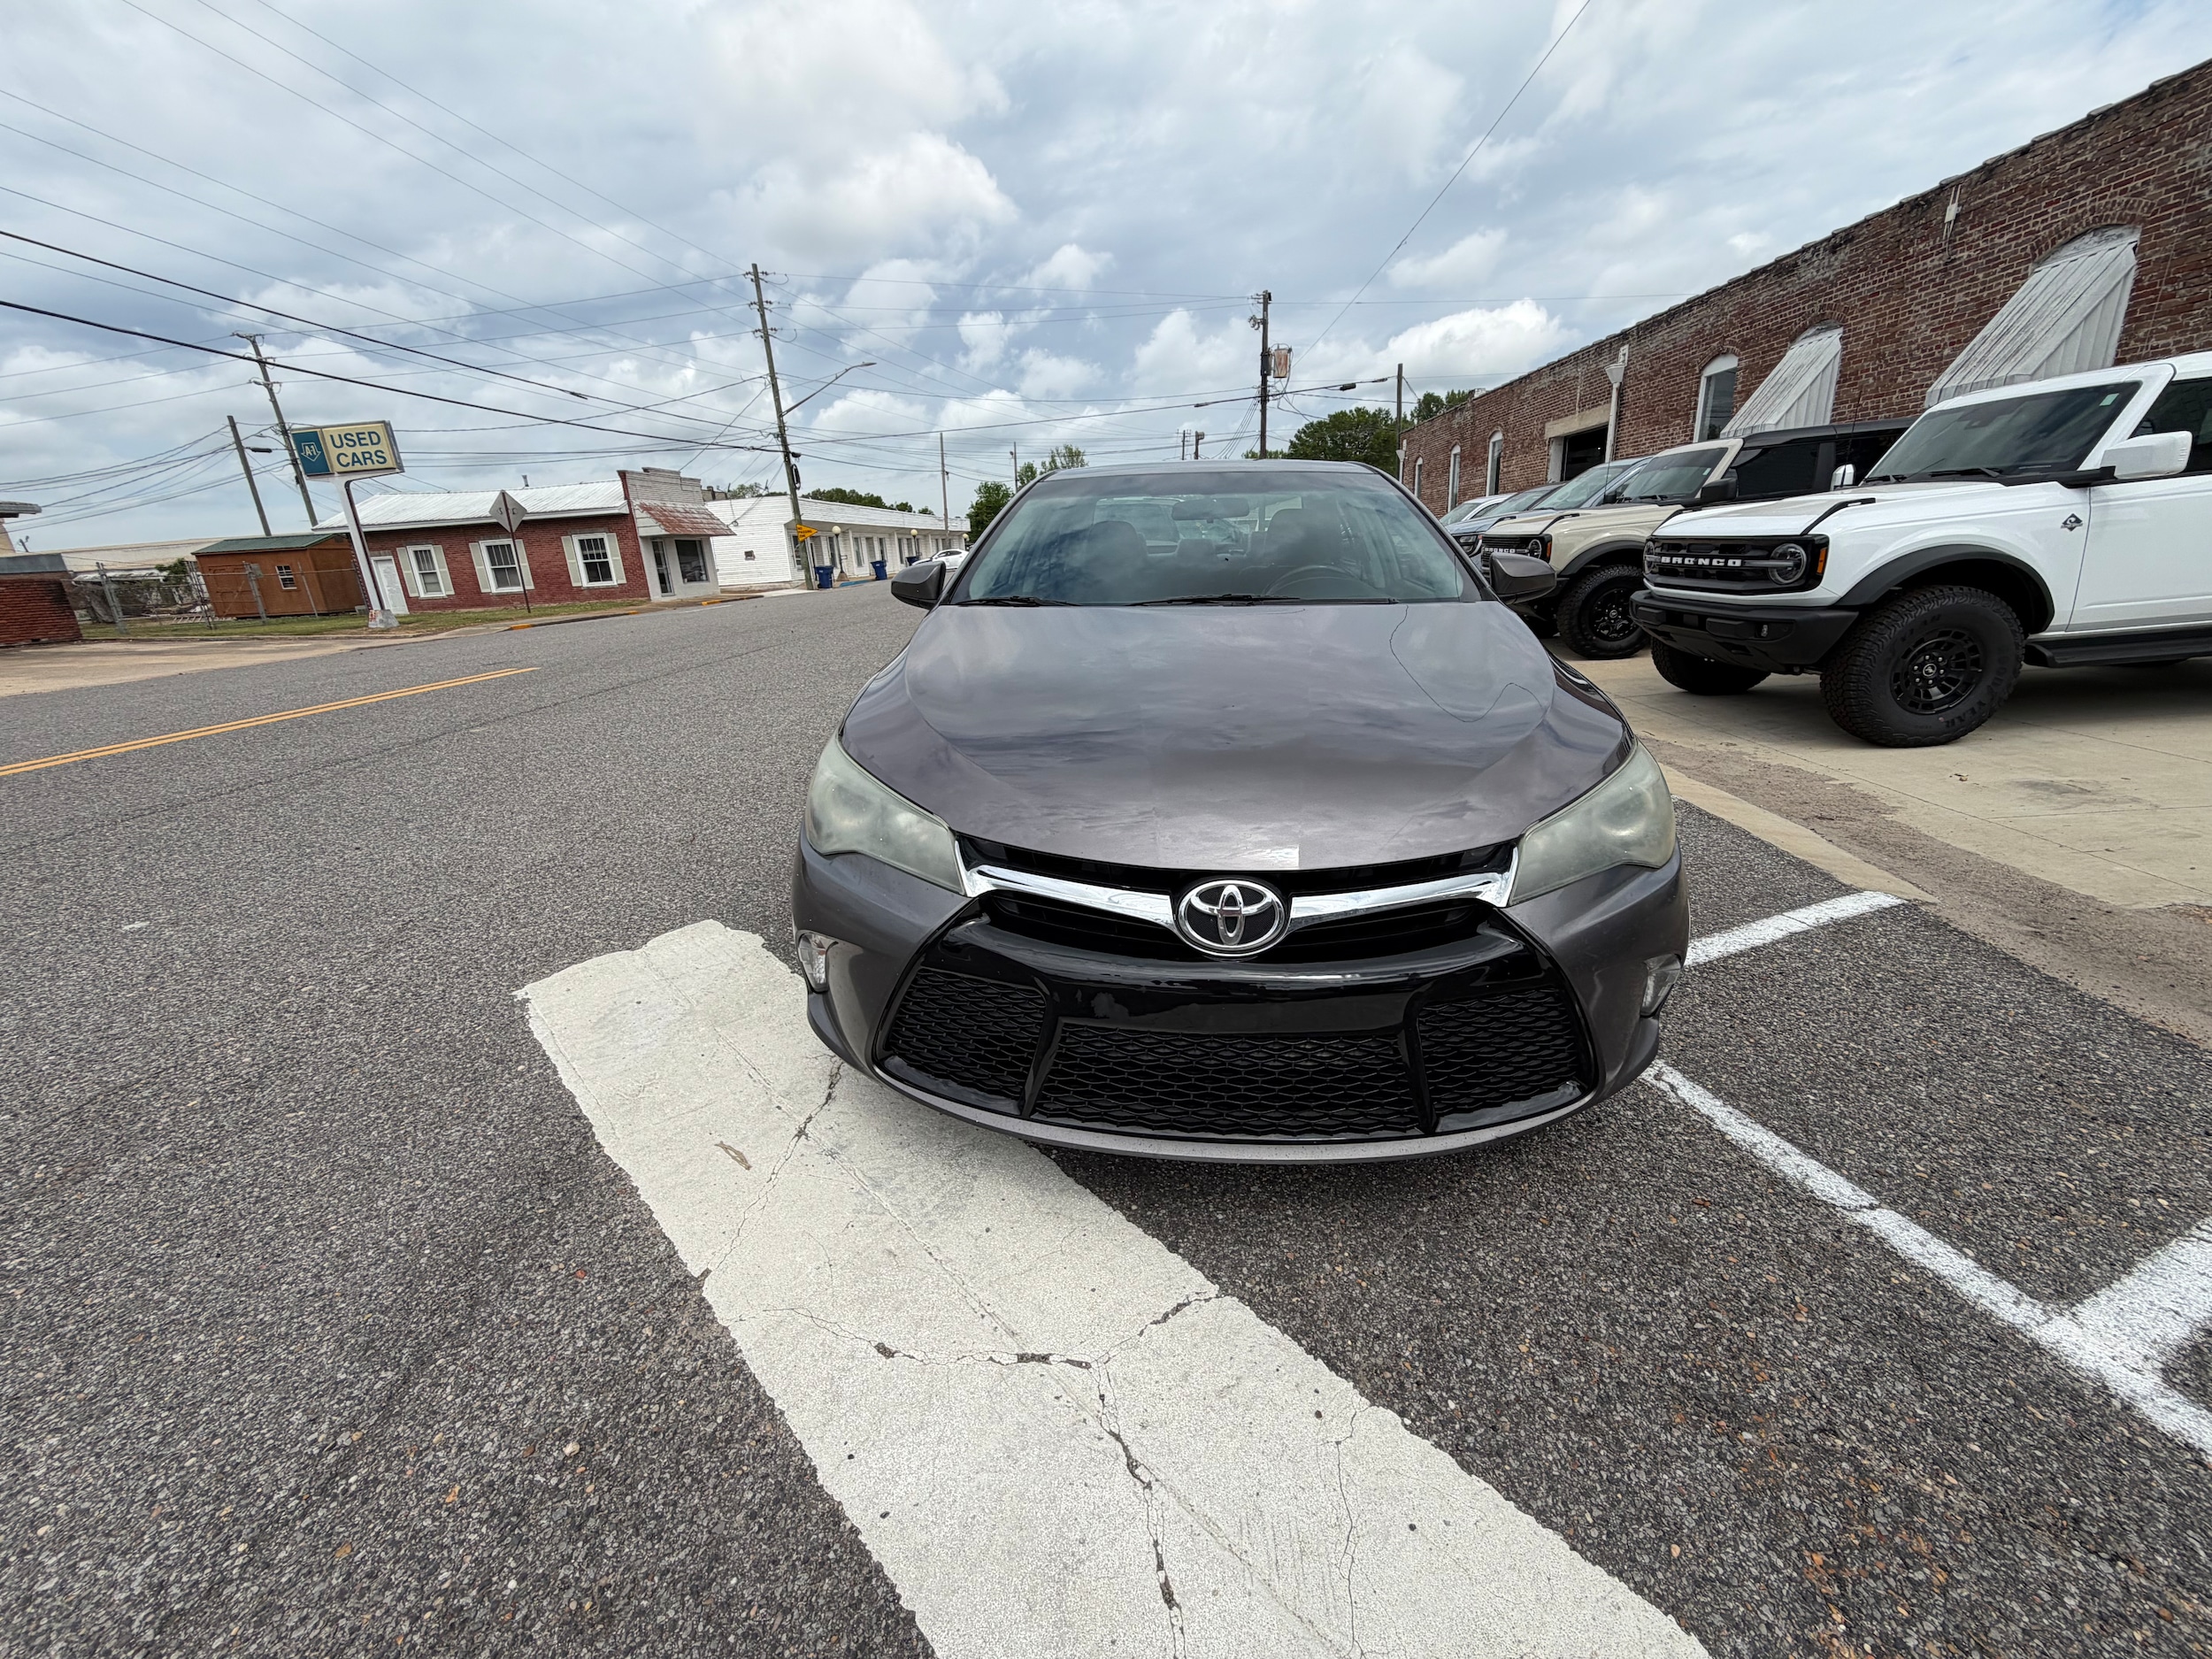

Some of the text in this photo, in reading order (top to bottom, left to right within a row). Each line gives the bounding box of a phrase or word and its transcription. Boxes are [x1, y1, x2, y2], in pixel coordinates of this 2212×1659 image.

[330, 431, 381, 449] USED
[336, 449, 388, 468] CARS
[1661, 556, 1741, 567] BRONCO
